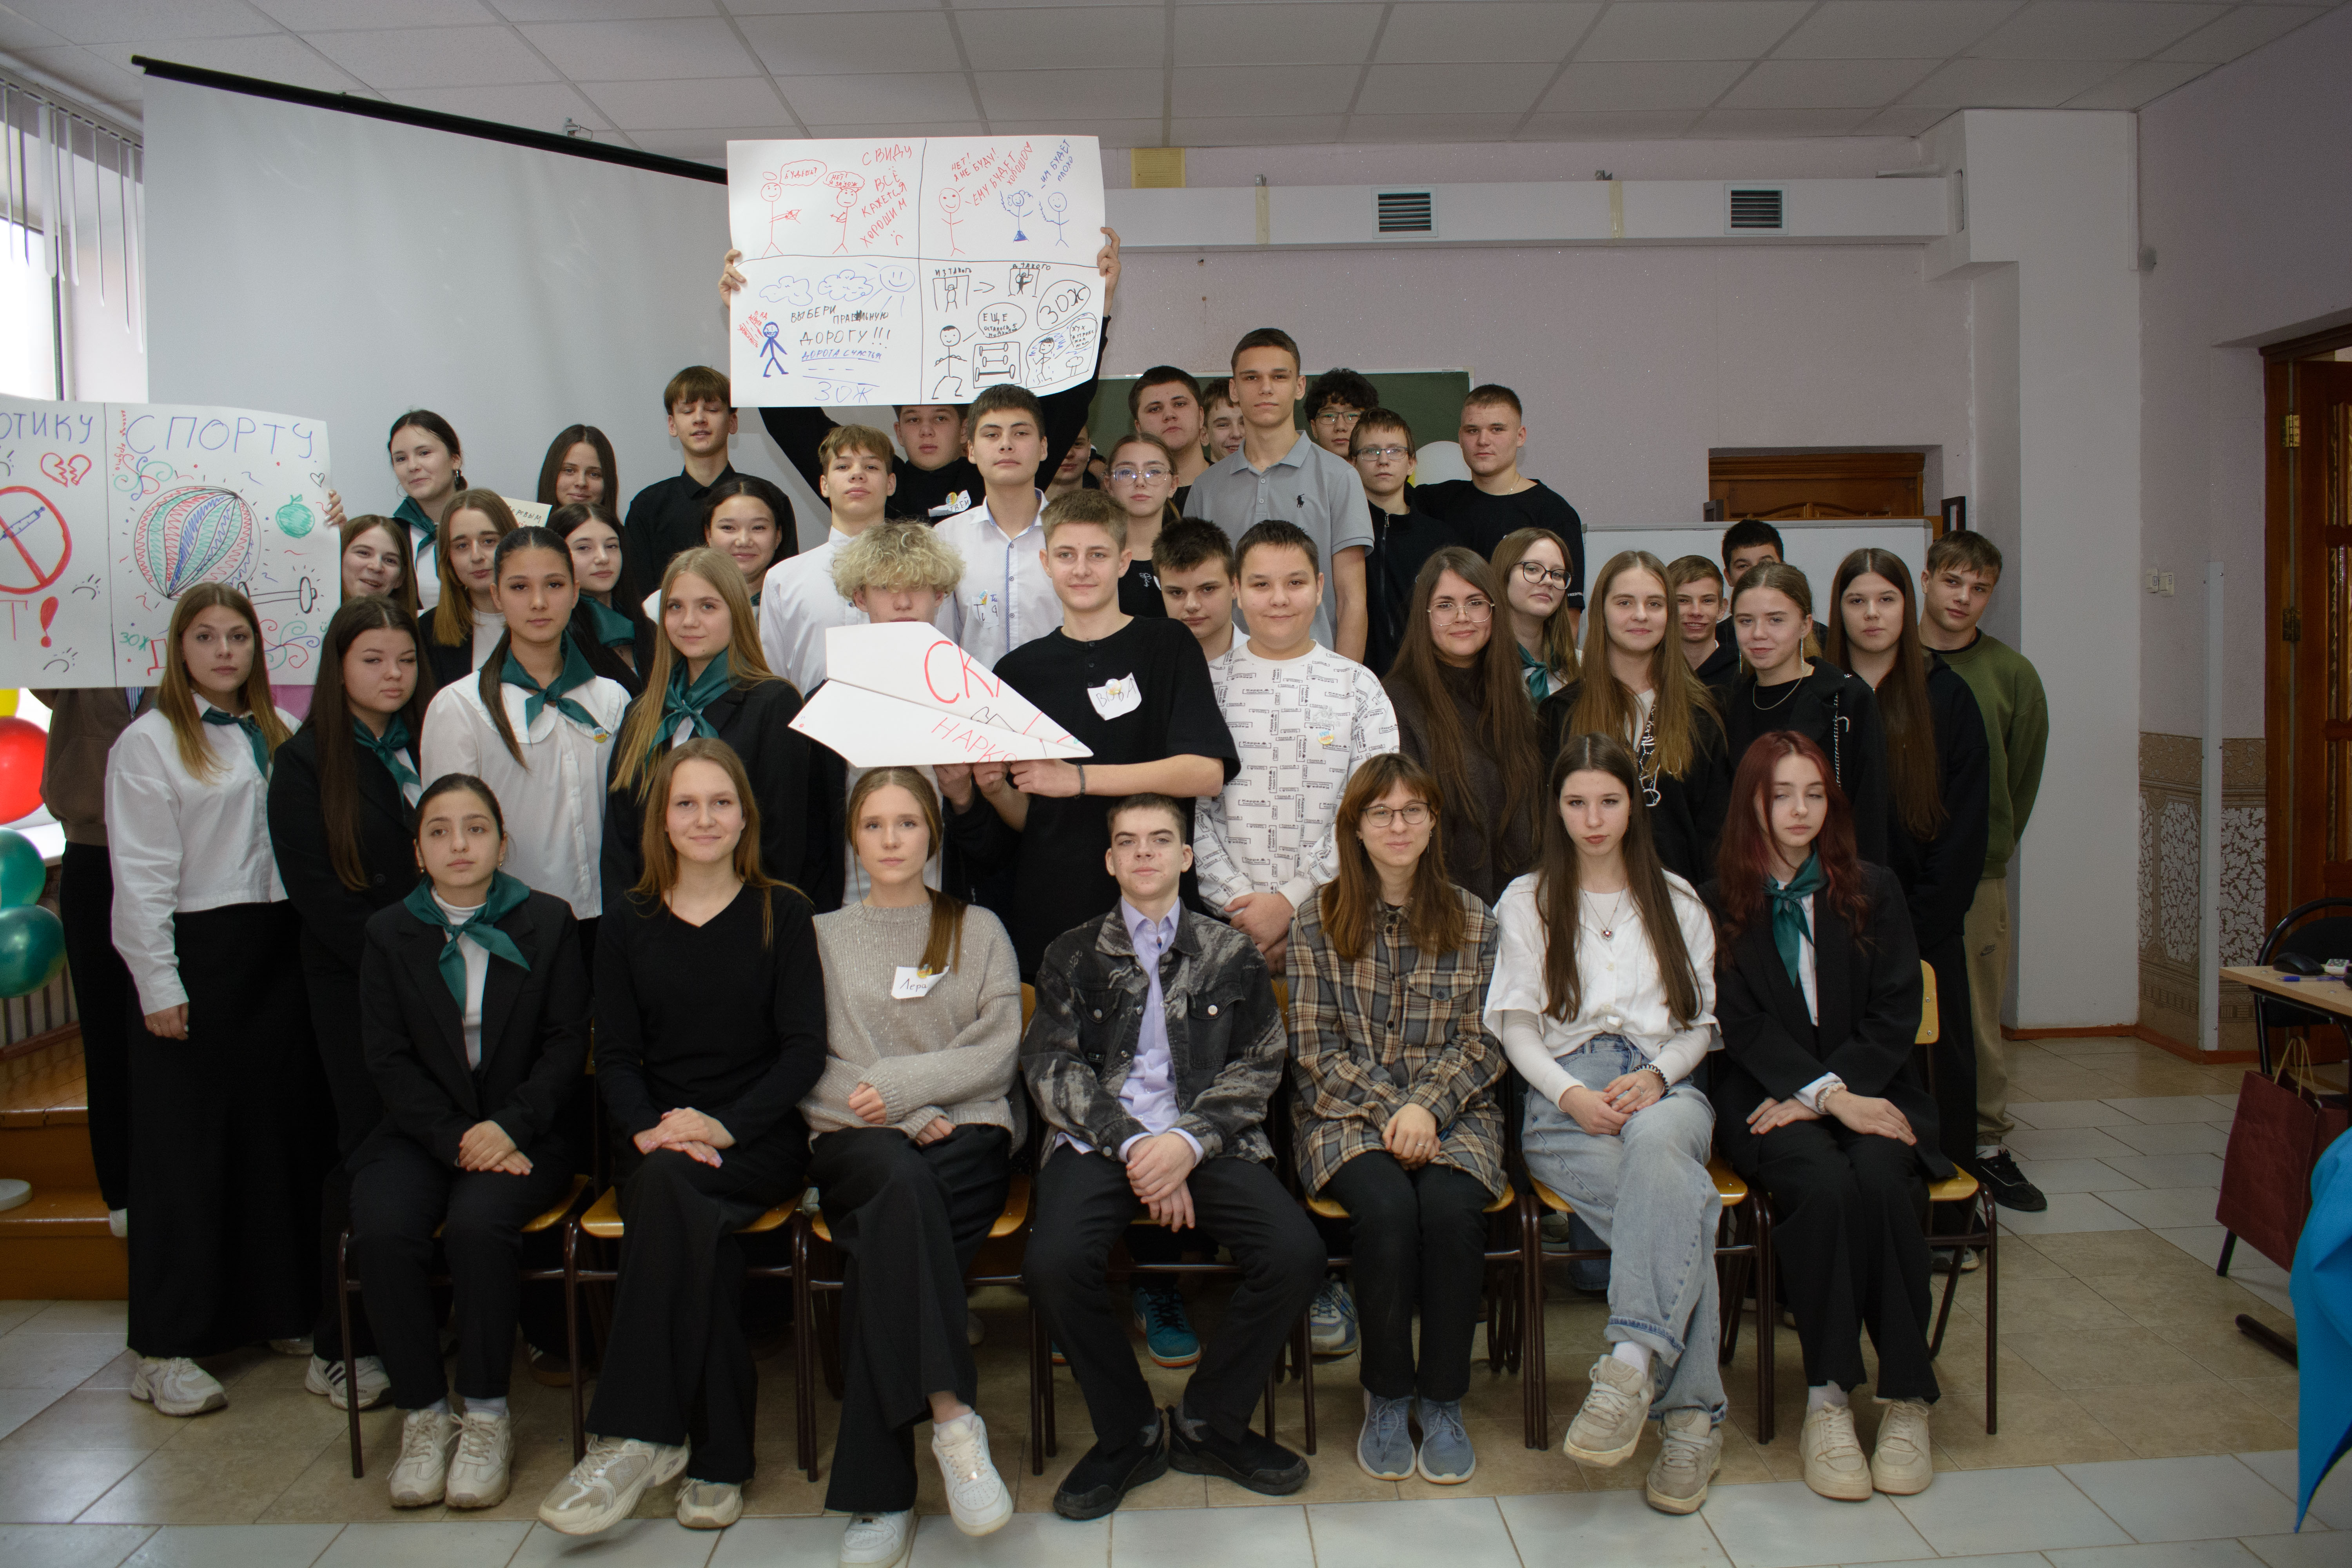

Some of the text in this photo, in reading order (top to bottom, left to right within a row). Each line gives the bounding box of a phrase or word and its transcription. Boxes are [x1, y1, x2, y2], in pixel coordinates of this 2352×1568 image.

[863, 144, 912, 165] С ВИДУ
[952, 152, 971, 171] НЕТ!
[960, 168, 971, 178] НЕ
[973, 147, 999, 172] БУДУ!
[973, 151, 1016, 206] ЕМУ БУДЕТ
[1041, 170, 1051, 183] ИМ
[1058, 156, 1073, 182] ПЛОХО
[862, 182, 907, 217] КАЖЕТСЯ
[860, 198, 907, 248] ХОРОШИМ
[791, 305, 836, 323] ВЫБЕРИ
[1040, 287, 1086, 324] ЗОЖ
[983, 312, 1008, 325] ЕЩЕ
[802, 349, 882, 360] ДОРОГА СЧАСТЬЯ
[815, 381, 873, 405] ЗОЖ
[120, 632, 151, 652] ЗОЖ
[900, 978, 928, 992] Лера
